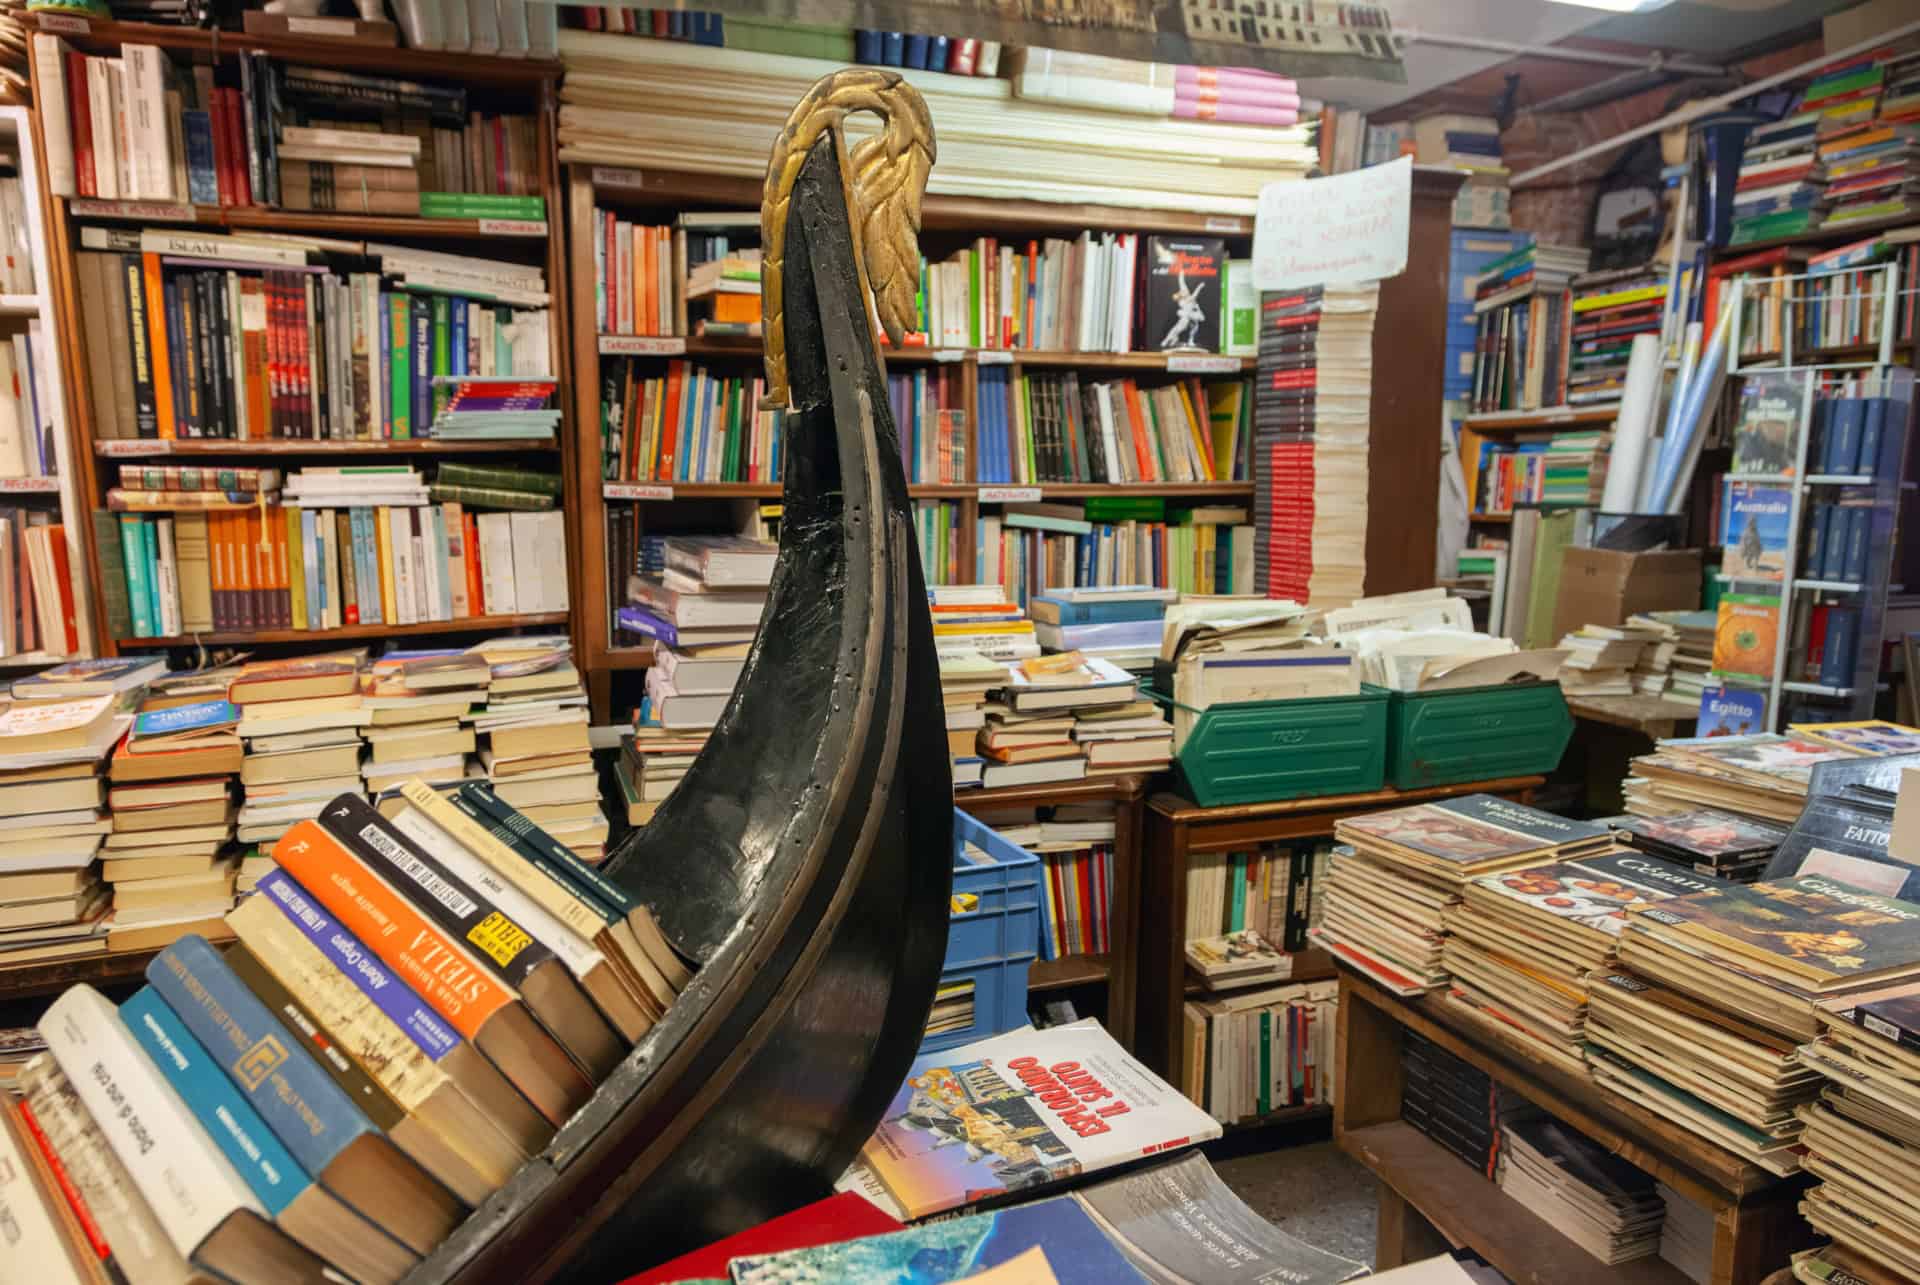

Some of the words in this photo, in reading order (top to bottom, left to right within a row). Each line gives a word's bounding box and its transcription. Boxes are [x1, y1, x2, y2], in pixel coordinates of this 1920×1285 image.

[167, 239, 219, 256] ISLAM
[1734, 501, 1788, 514] Australia
[1710, 700, 1753, 717] Egitto
[1844, 825, 1890, 845] FATTO
[1616, 859, 1723, 896] Cézann
[1799, 879, 1919, 920] Giorgione
[407, 930, 487, 1003] STELLA
[1096, 1100, 1131, 1118] IL
